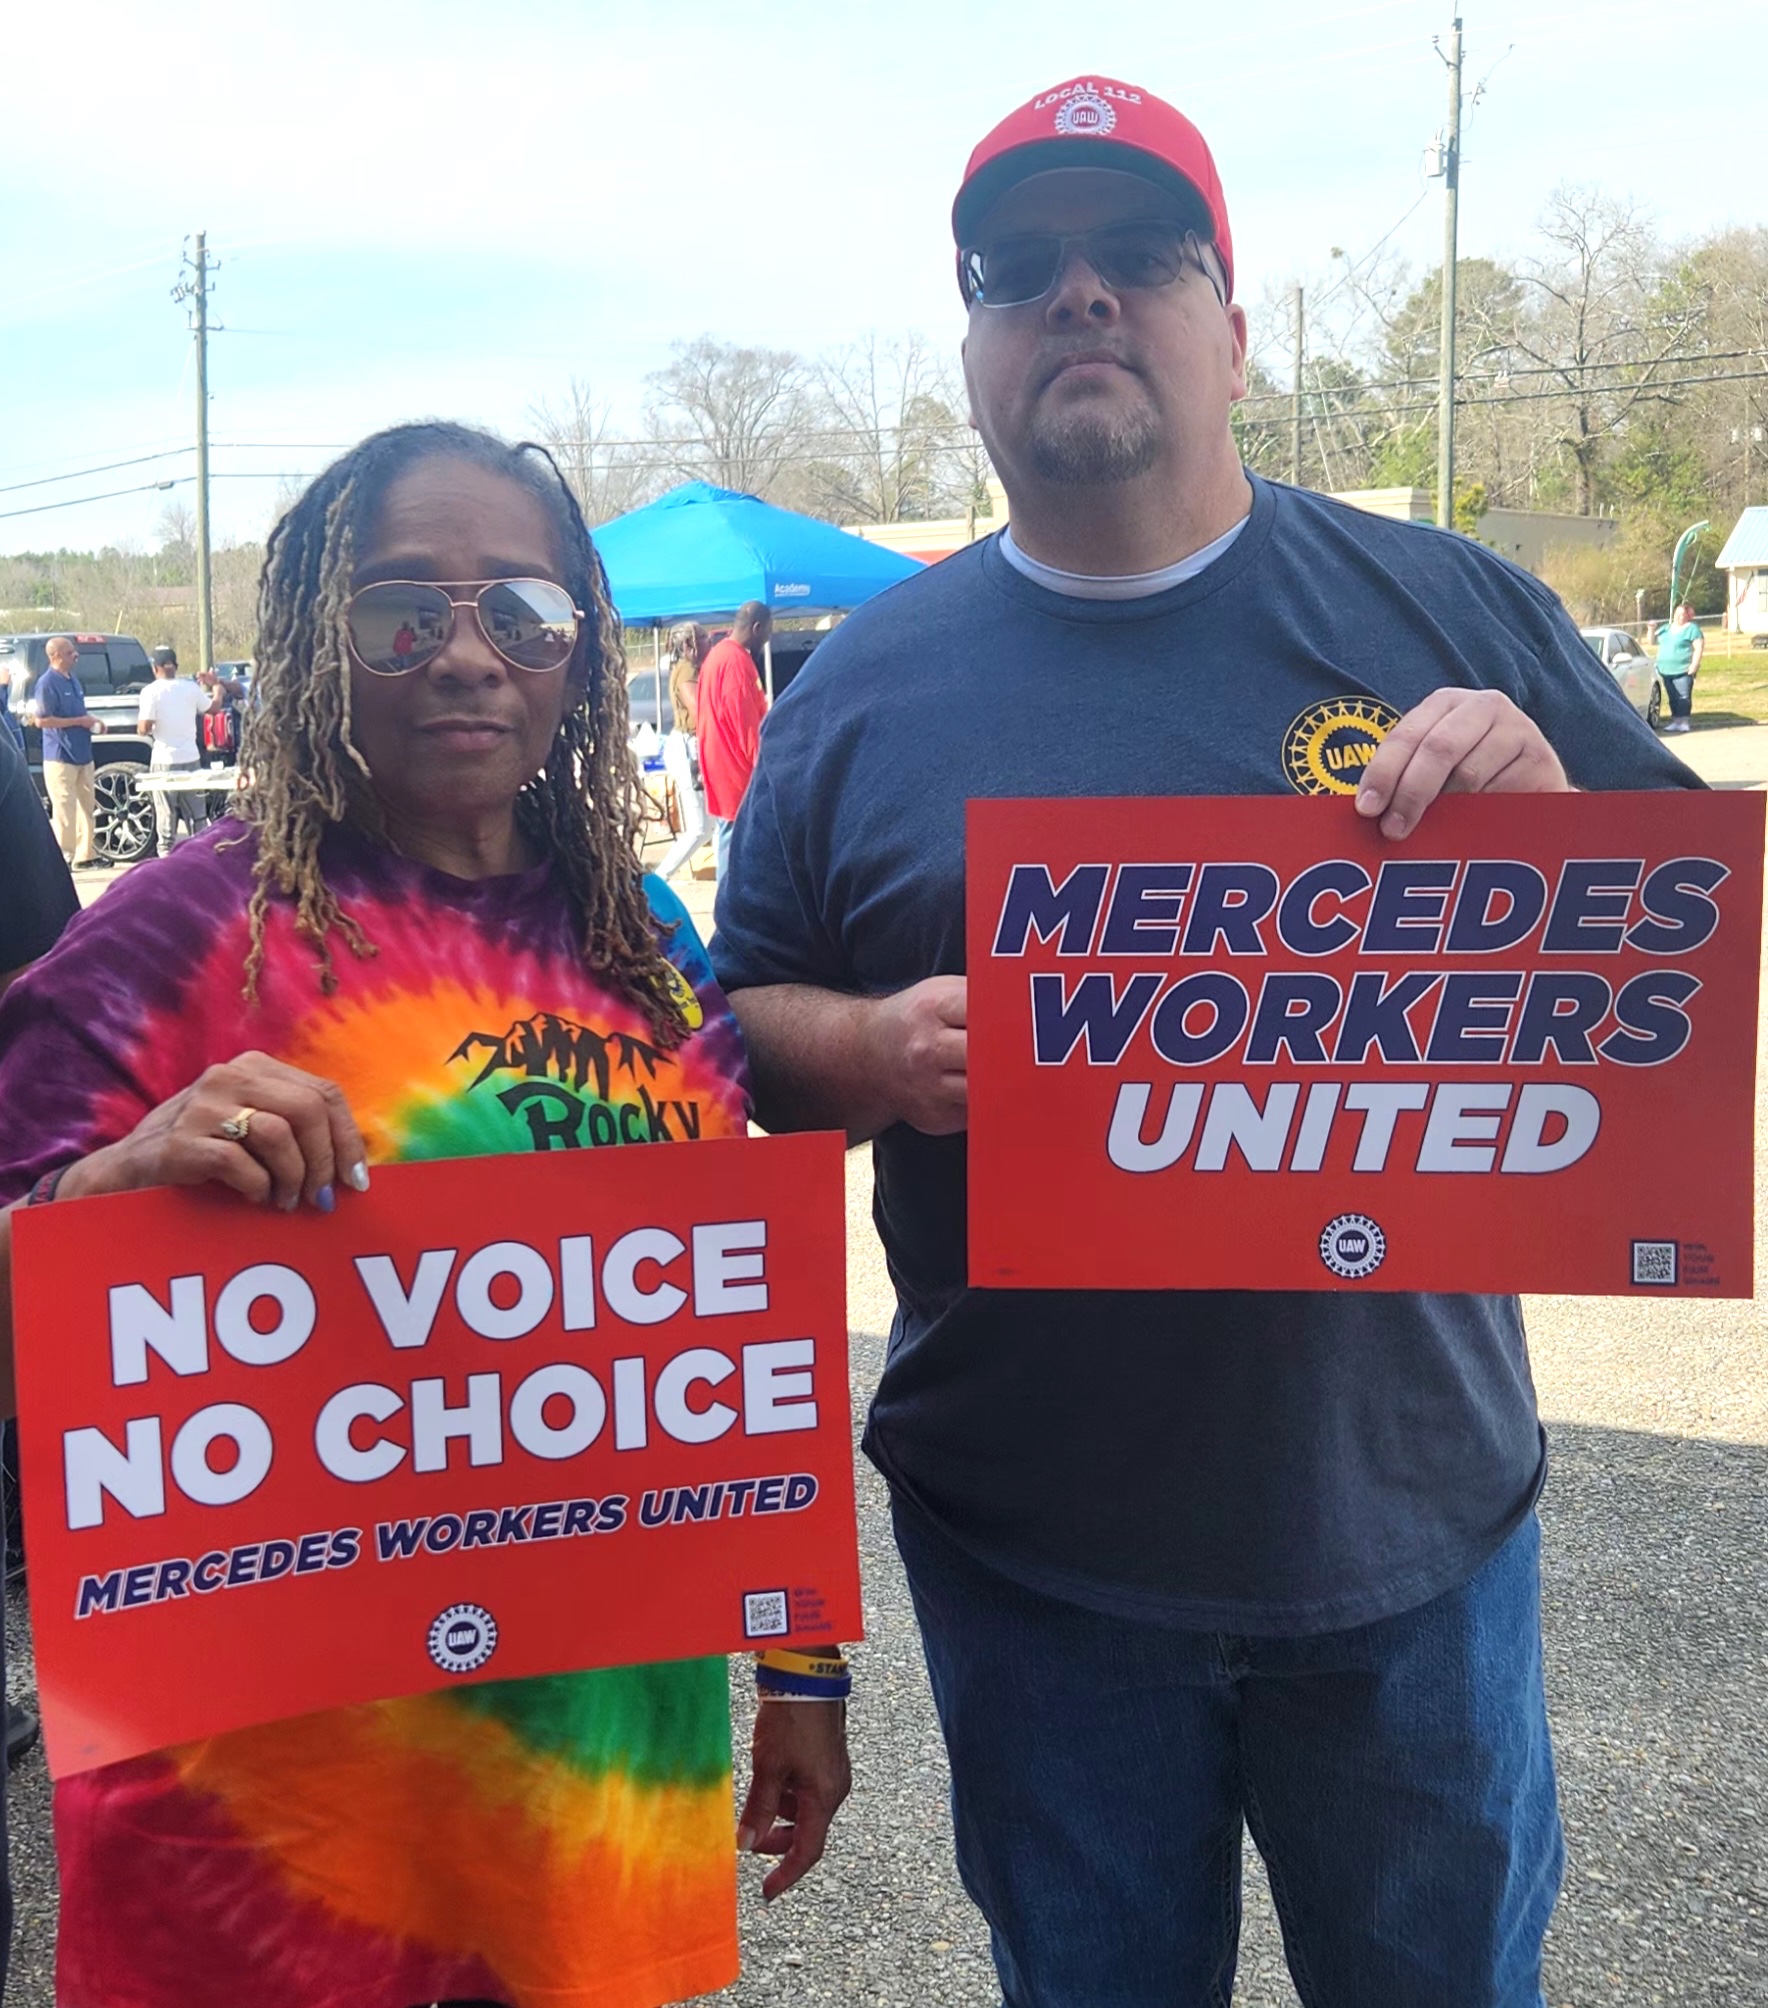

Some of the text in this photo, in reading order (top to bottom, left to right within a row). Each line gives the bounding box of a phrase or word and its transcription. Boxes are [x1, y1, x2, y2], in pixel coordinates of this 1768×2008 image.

[1034, 82, 1142, 109] LOCAL 112
[1072, 111, 1098, 124] UAW
[1325, 743, 1377, 770] UAW
[991, 857, 1732, 956] MERCEDES
[1029, 969, 1704, 1067] WORKERS
[1106, 1081, 1602, 1174] UNITED
[1338, 1238, 1366, 1253] UAW
[107, 1219, 769, 1387] NO VOICE
[63, 1338, 818, 1530] NO CHOICE
[74, 1474, 819, 1620] MERCEDES WORKERS UNITED
[447, 1629, 477, 1648] UAW
